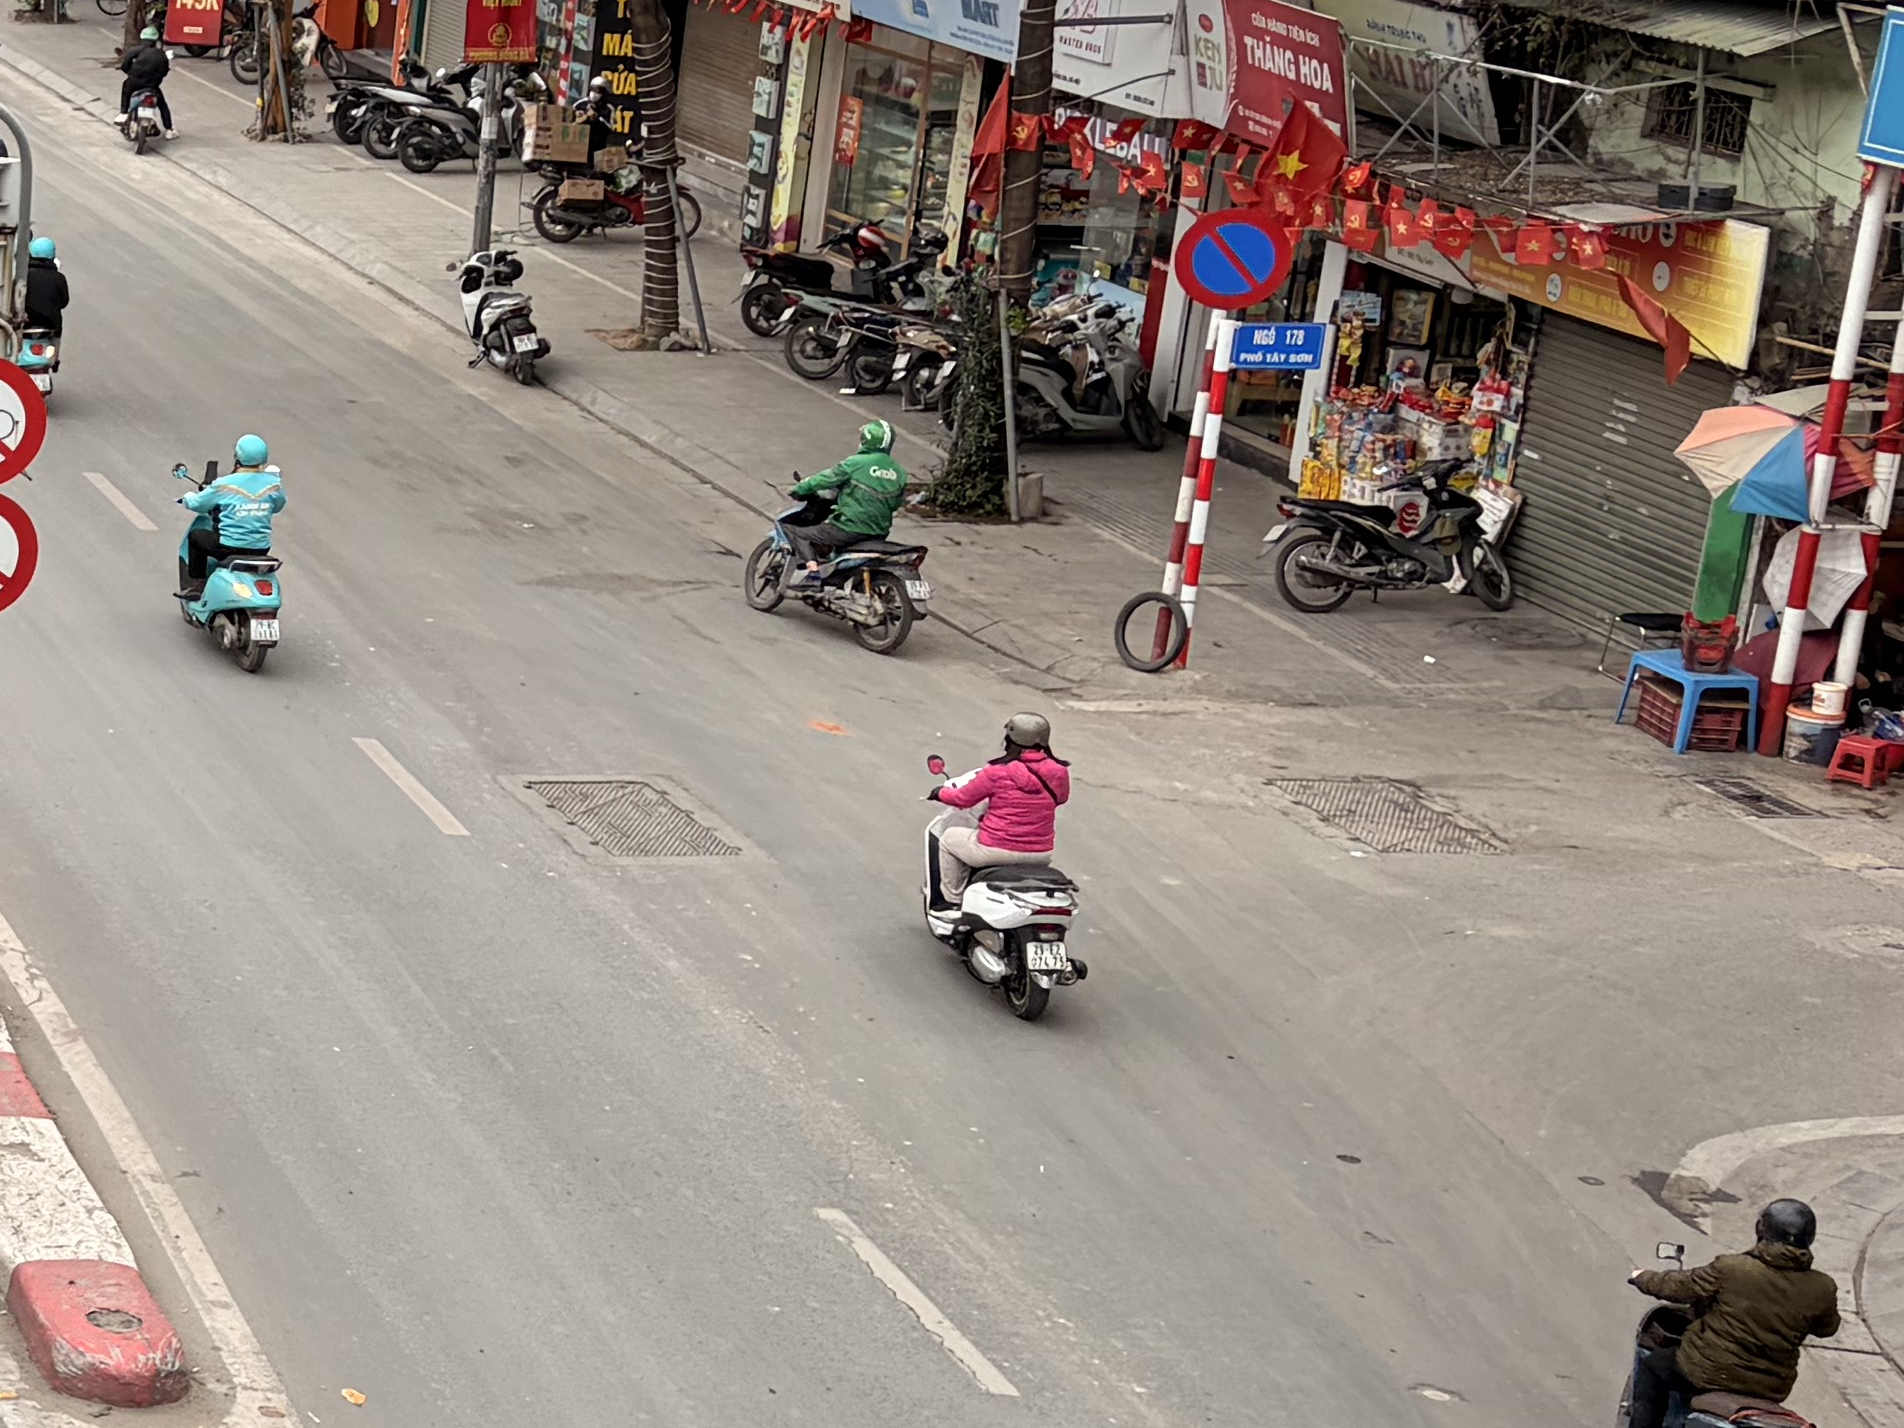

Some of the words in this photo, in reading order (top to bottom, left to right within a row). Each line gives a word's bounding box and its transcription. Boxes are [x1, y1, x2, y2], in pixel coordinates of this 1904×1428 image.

[1244, 35, 1296, 81] THĂNG
[1299, 55, 1334, 94] HOA
[1285, 329, 1305, 345] 178
[1266, 351, 1287, 363] TÂY
